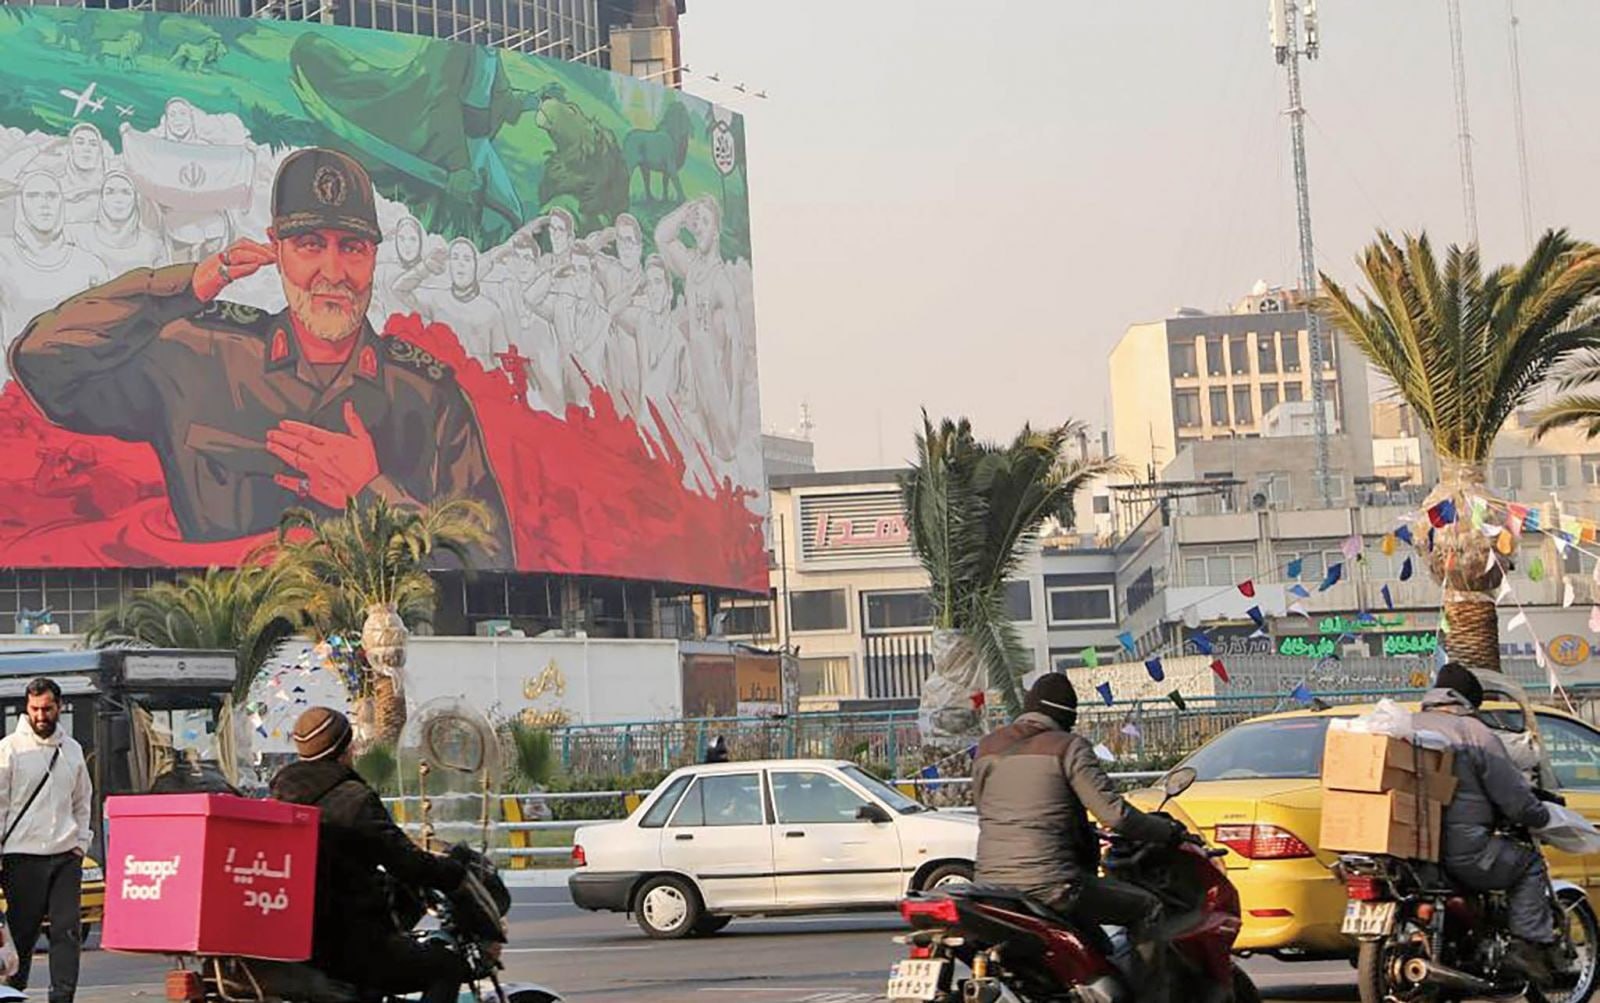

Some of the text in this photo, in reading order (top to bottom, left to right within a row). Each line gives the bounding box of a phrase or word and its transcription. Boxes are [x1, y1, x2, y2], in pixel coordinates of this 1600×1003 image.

[123, 854, 181, 880] Snapp!
[121, 878, 163, 900] Food
[243, 888, 289, 916] فود
